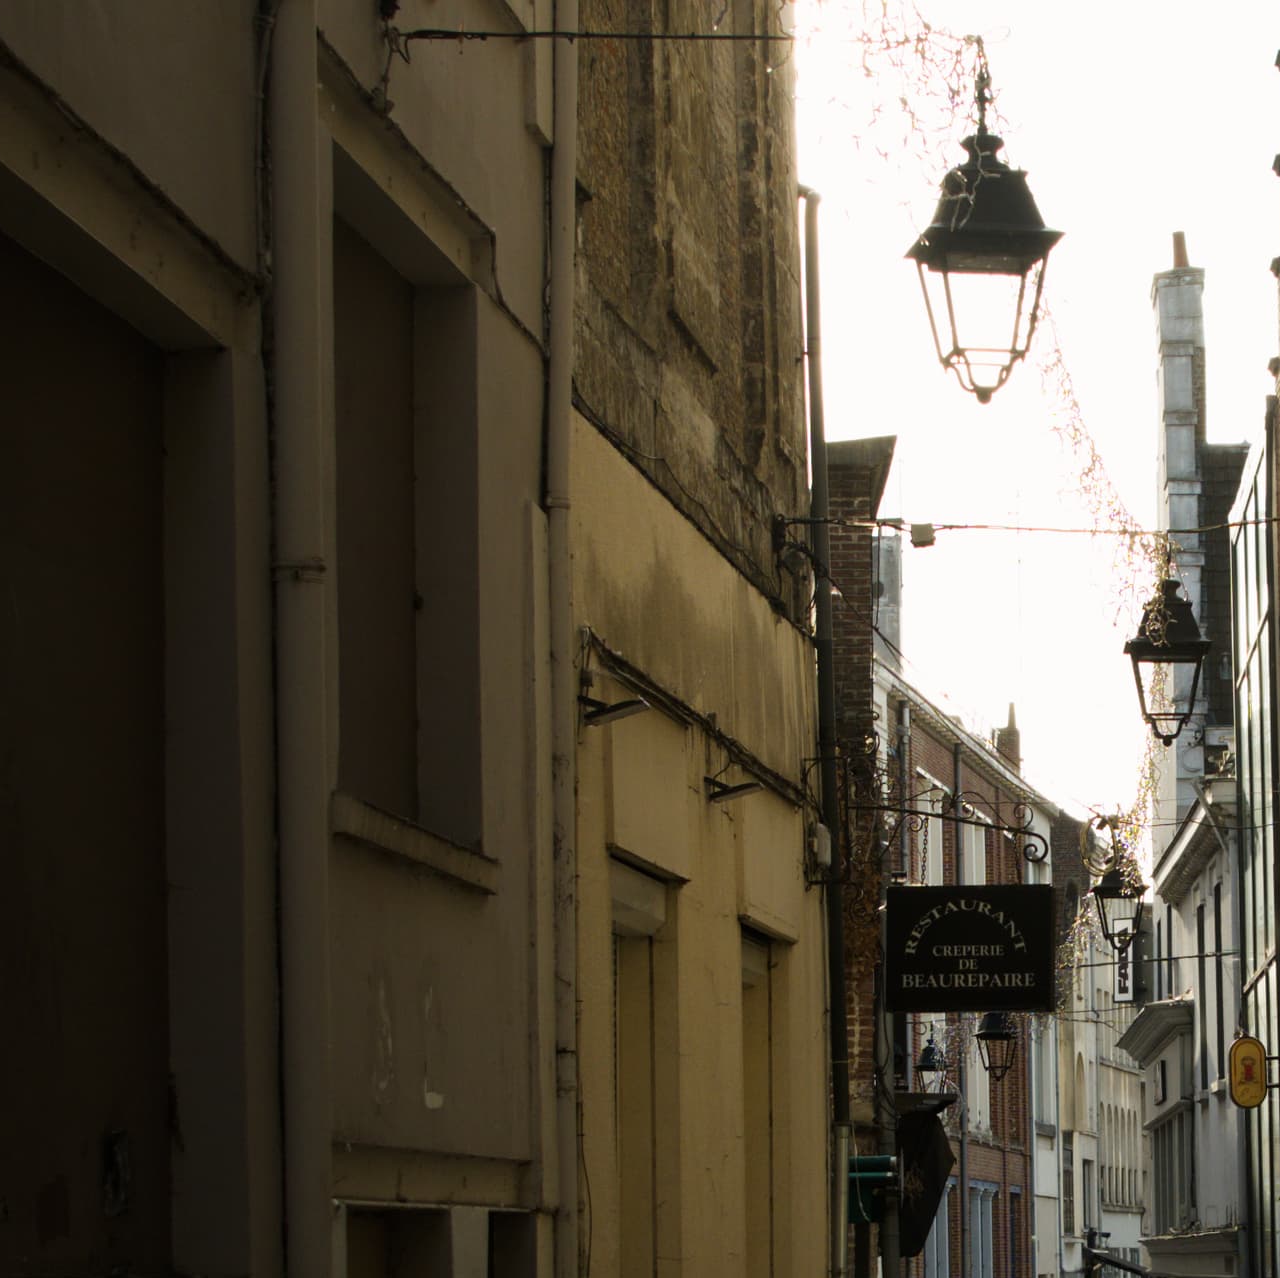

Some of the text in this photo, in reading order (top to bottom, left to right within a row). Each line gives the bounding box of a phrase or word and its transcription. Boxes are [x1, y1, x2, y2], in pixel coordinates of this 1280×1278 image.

[905, 898, 1027, 956] RESTAURANT
[958, 958, 978, 970] DE
[901, 972, 1036, 989] BEAUREPAIRE
